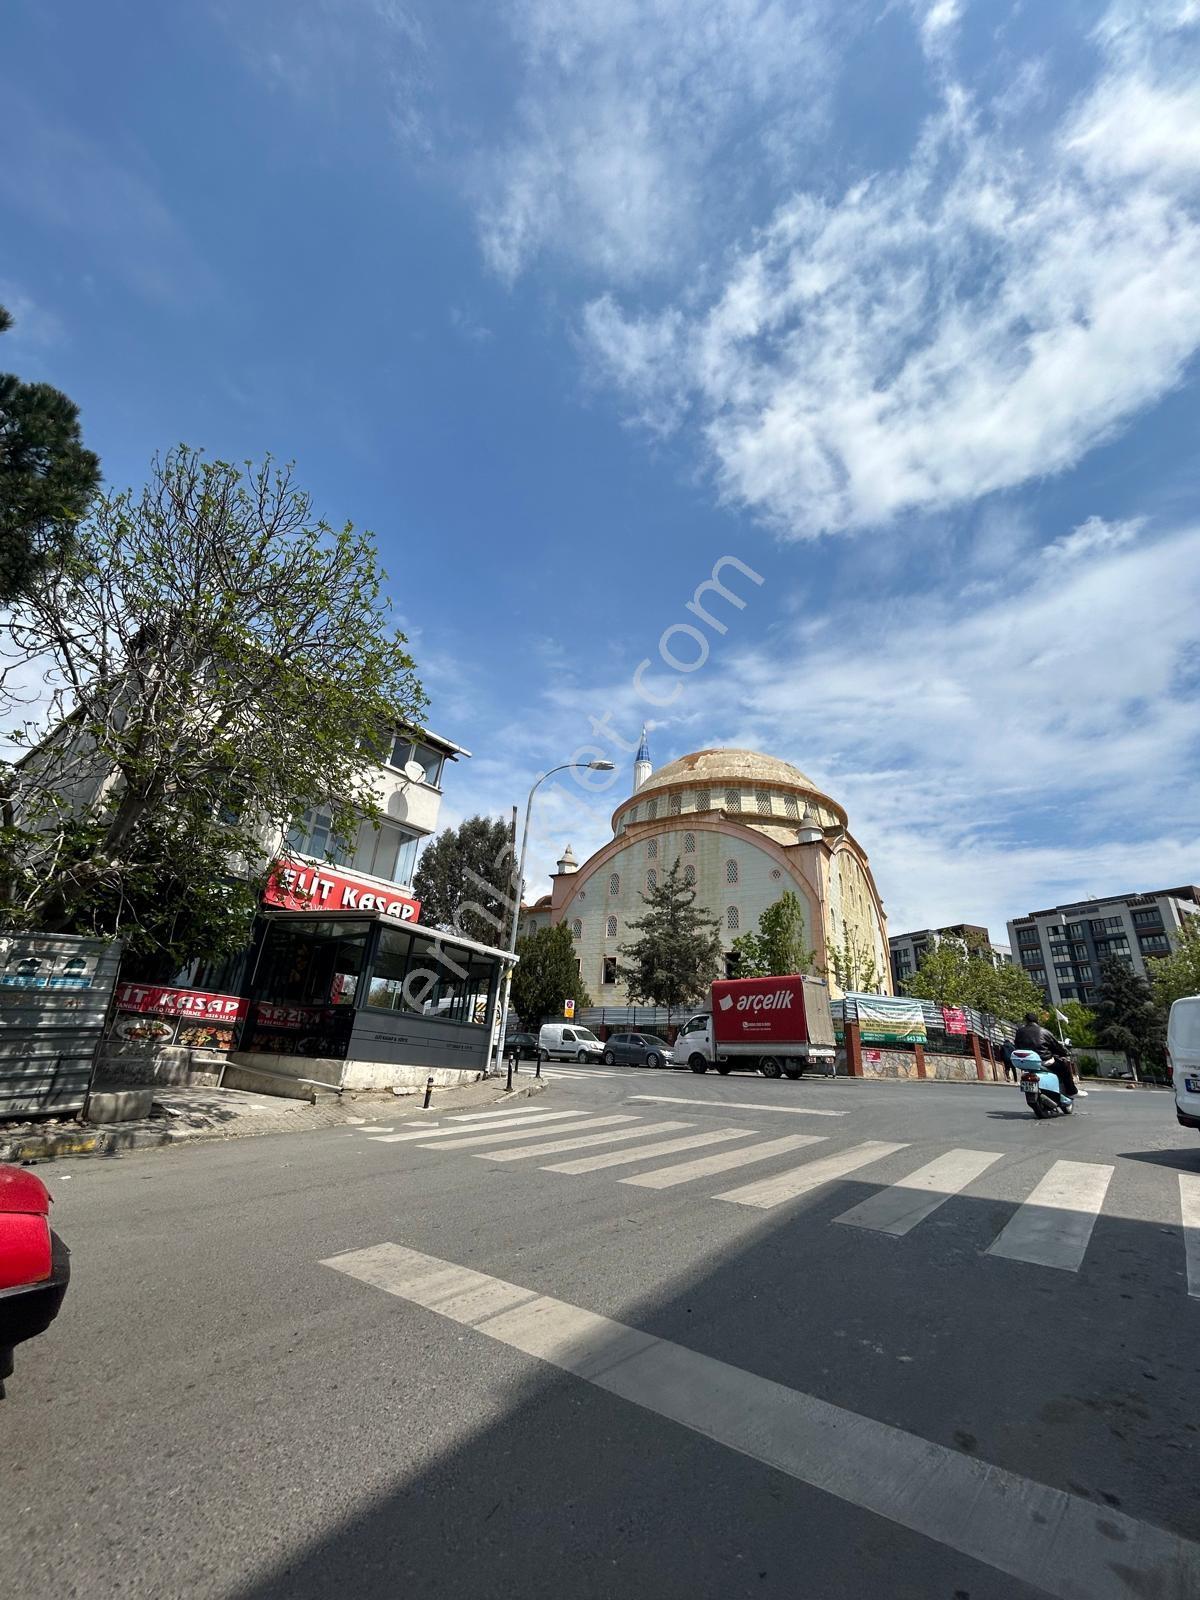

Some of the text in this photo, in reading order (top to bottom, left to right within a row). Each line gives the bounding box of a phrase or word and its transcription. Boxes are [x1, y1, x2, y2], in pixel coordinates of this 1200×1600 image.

[280, 868, 416, 920] ELİT KASAP
[159, 992, 240, 1014] KASAP
[736, 989, 795, 1014] arçelik
